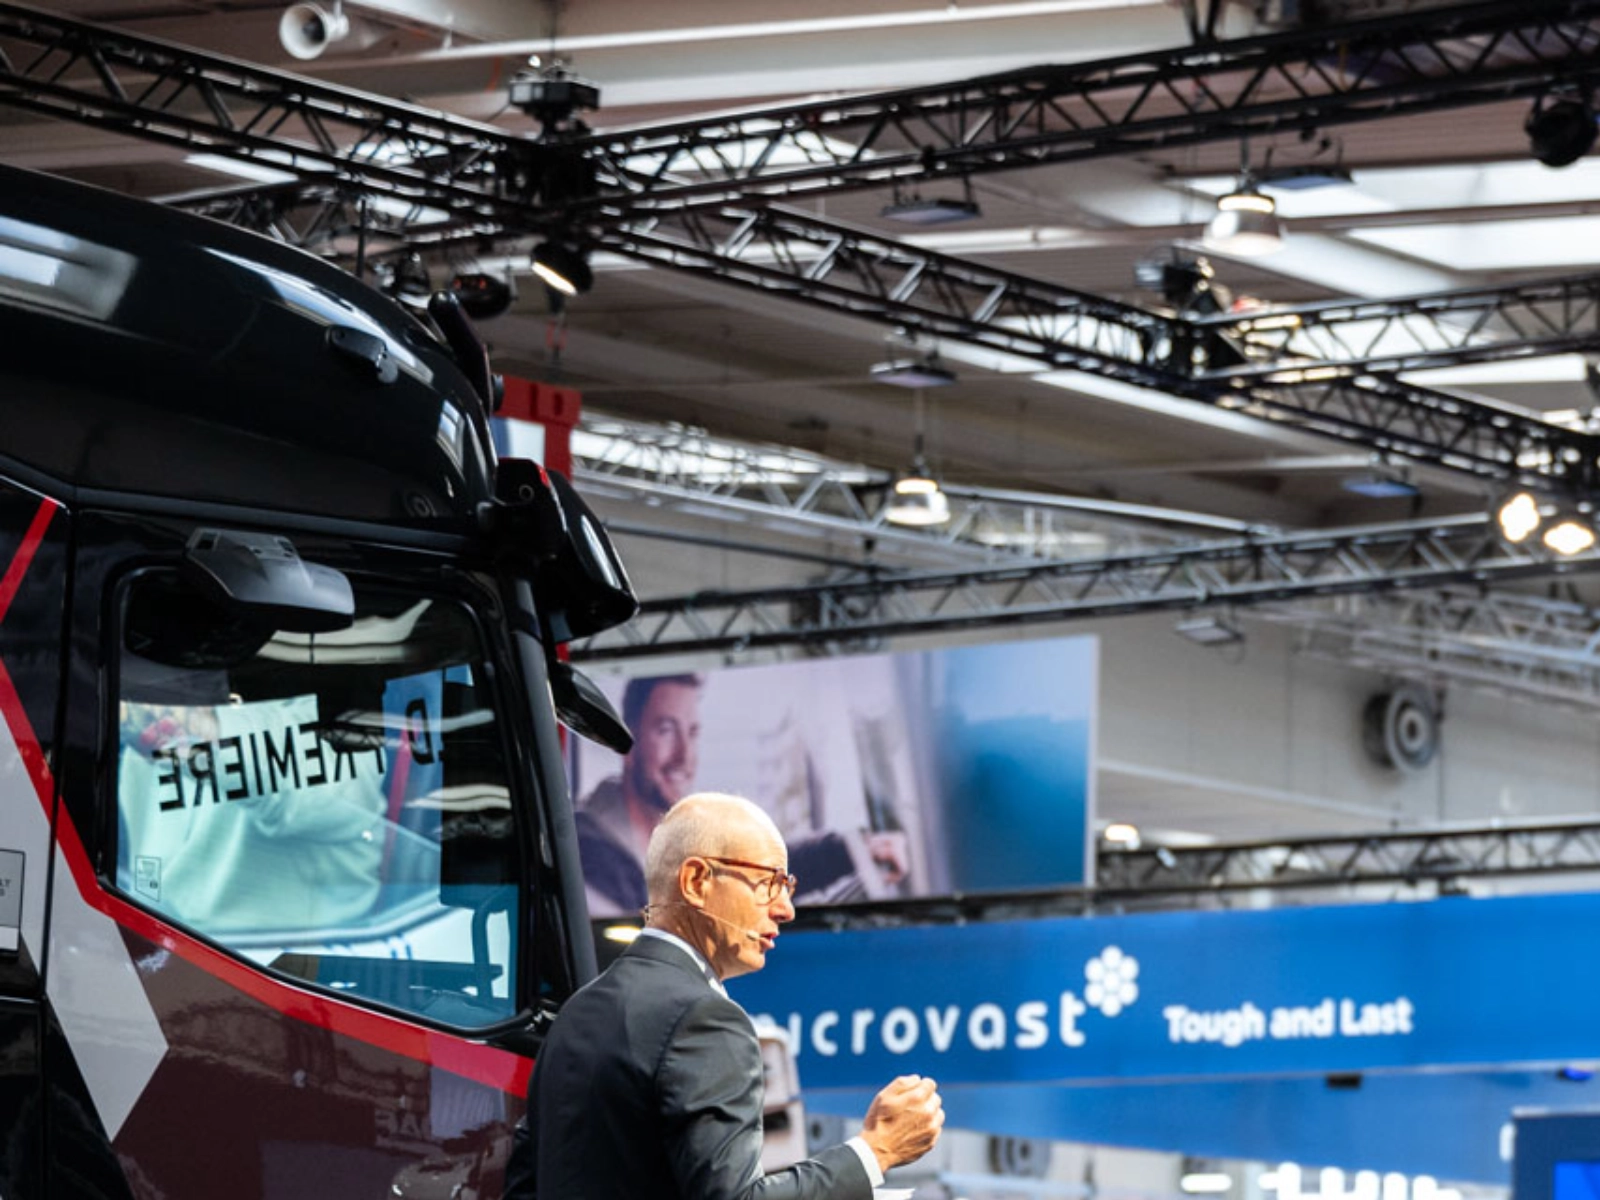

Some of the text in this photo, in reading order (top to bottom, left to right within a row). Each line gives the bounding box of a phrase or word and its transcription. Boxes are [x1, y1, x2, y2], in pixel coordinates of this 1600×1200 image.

[1163, 996, 1415, 1047] Tough and Last
